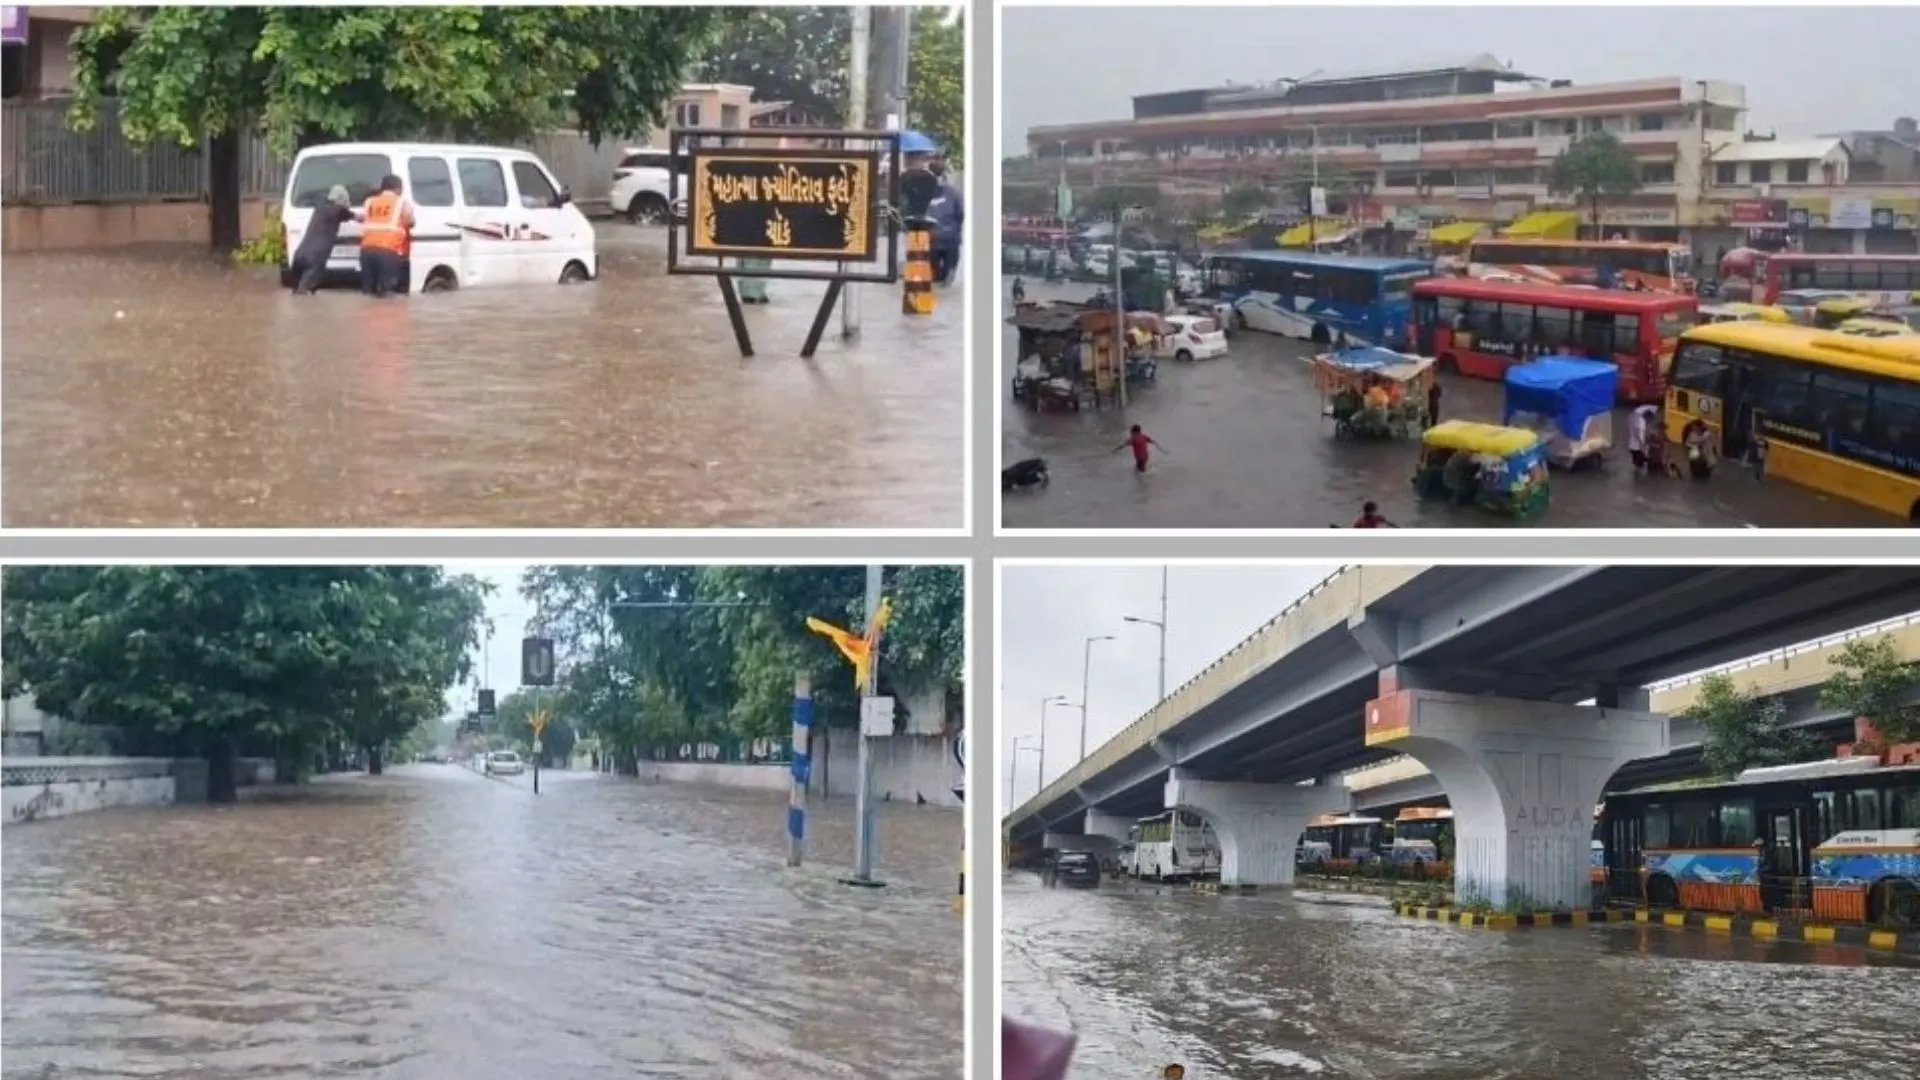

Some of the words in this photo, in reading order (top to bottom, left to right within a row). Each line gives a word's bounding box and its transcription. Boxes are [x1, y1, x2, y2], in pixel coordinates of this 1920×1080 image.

[713, 174, 758, 203] મહાત્મા
[761, 163, 824, 203] જ્યોતિરાવ
[766, 207, 791, 246] ચોક
[1515, 804, 1585, 831] AUDA
